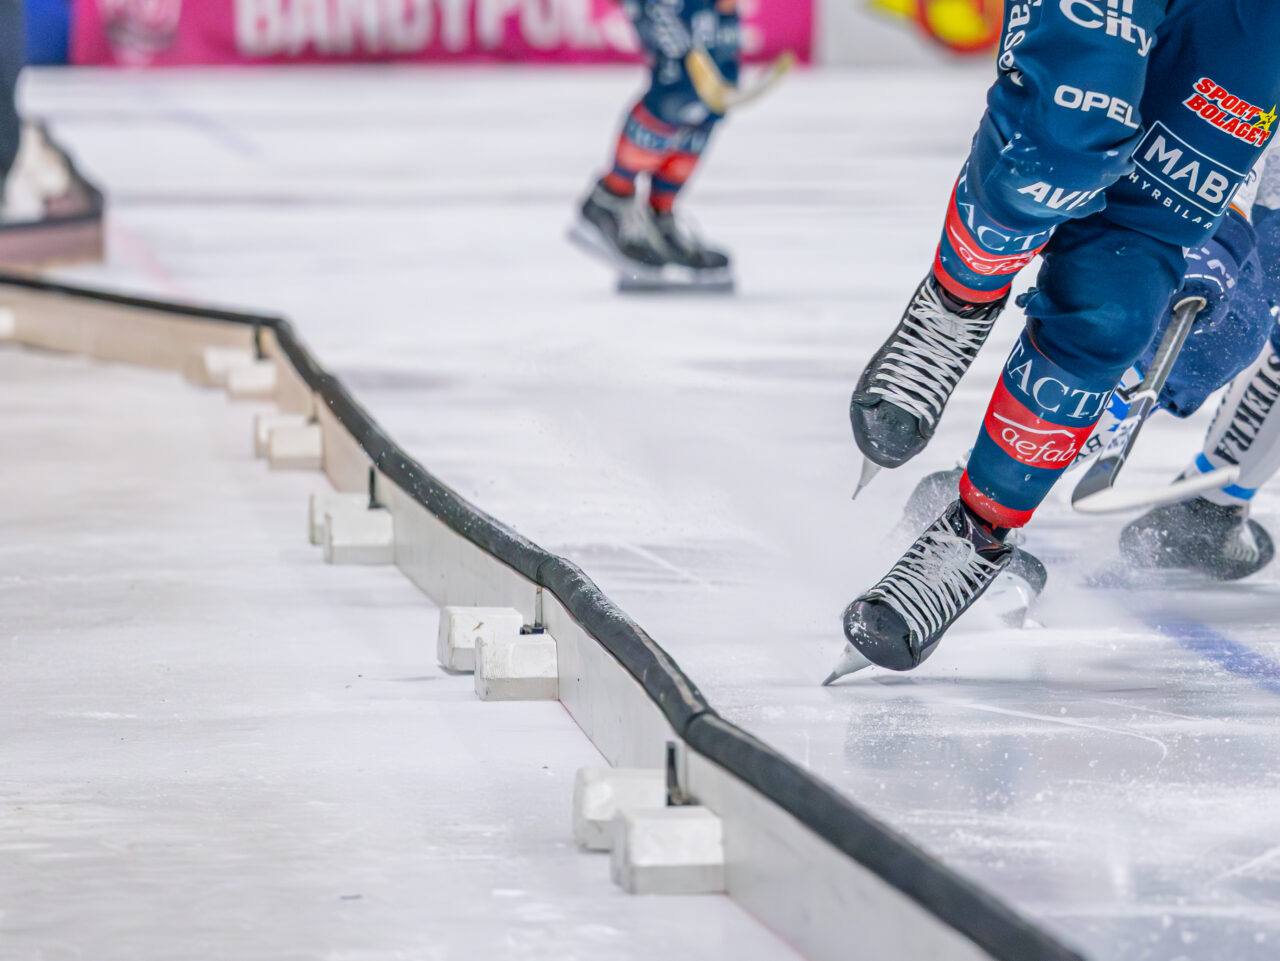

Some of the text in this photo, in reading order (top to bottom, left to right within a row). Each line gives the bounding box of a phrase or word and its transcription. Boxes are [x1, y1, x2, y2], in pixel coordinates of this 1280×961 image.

[1053, 84, 1141, 129] OPEL
[1183, 93, 1272, 148] BOLAGET
[1194, 76, 1264, 123] SPORT
[1143, 133, 1231, 206] MAB
[1128, 172, 1213, 231] HYRBILAR
